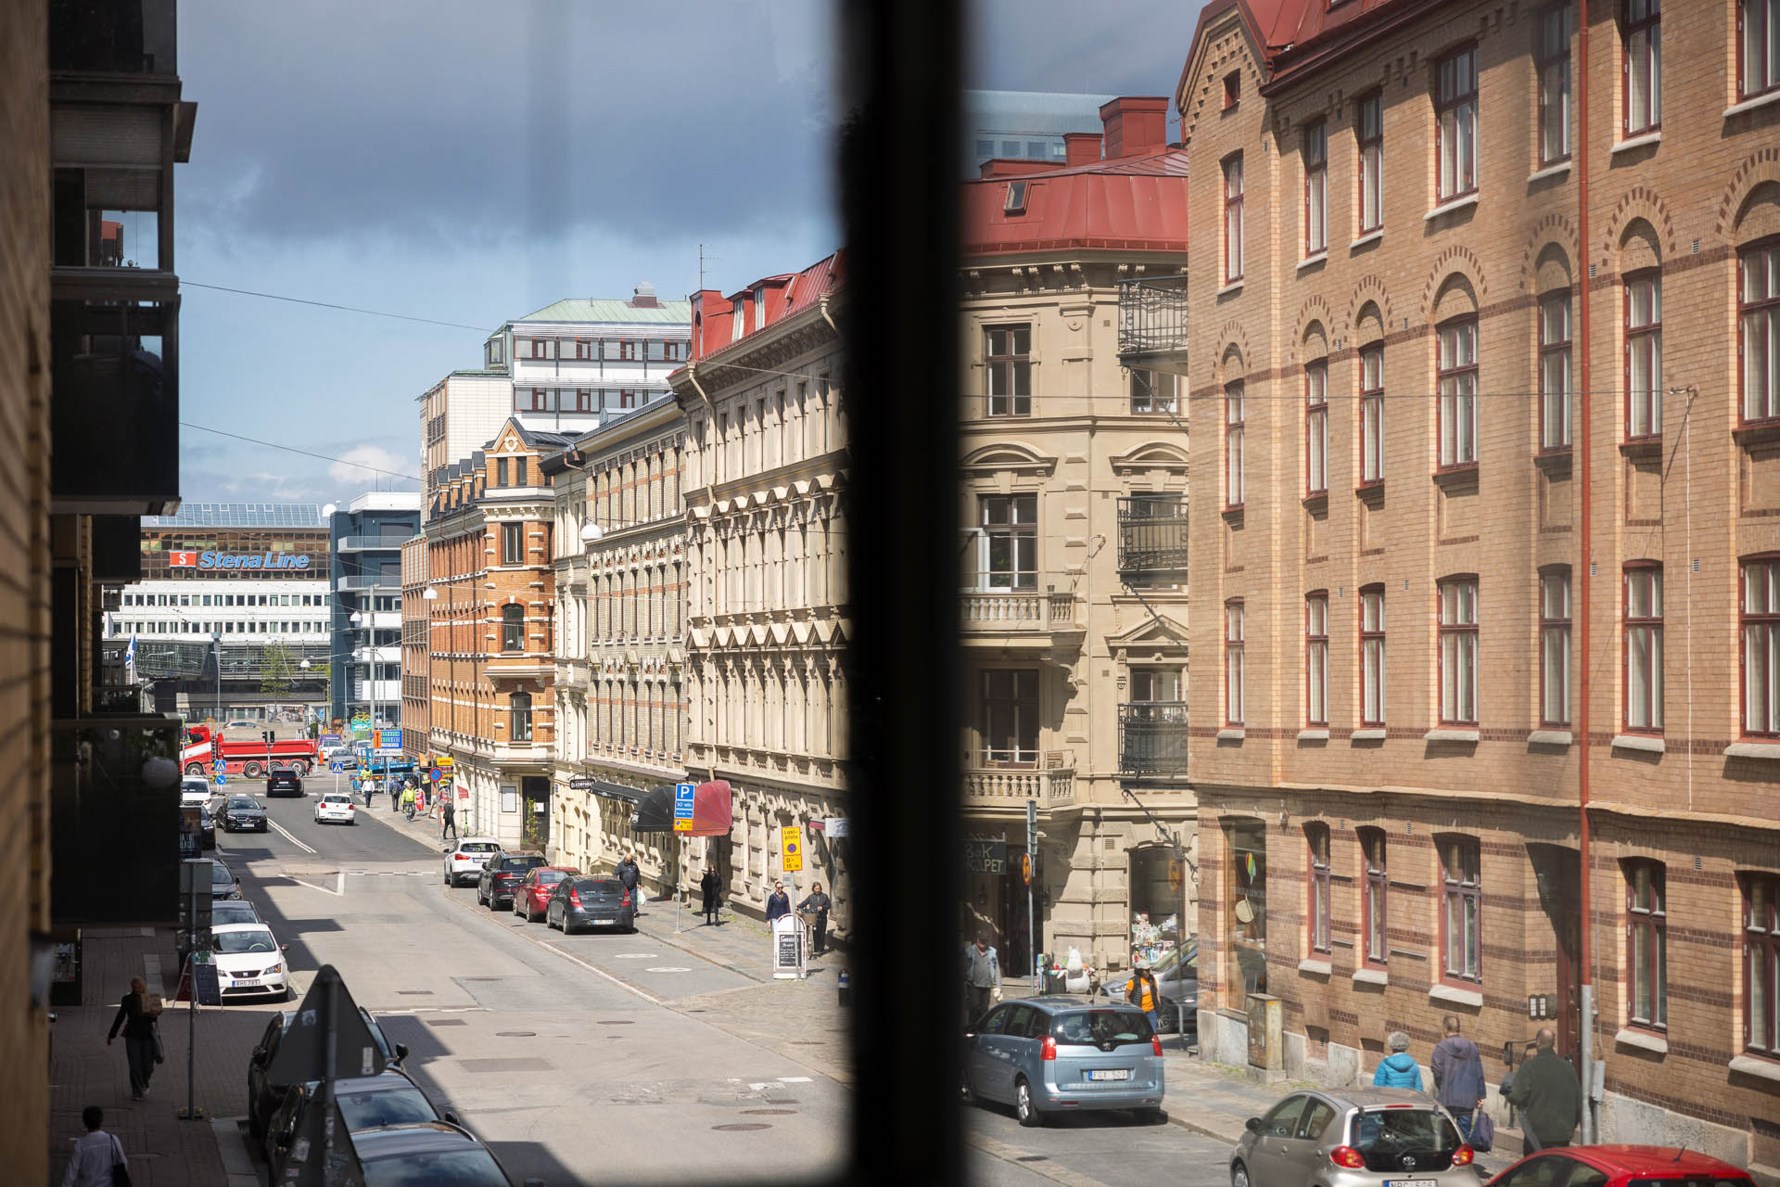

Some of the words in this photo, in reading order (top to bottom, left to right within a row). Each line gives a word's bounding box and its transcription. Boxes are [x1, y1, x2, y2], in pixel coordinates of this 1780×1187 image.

[179, 553, 187, 565] S
[200, 551, 261, 569] Stena
[263, 551, 310, 569] Line
[680, 786, 690, 799] P
